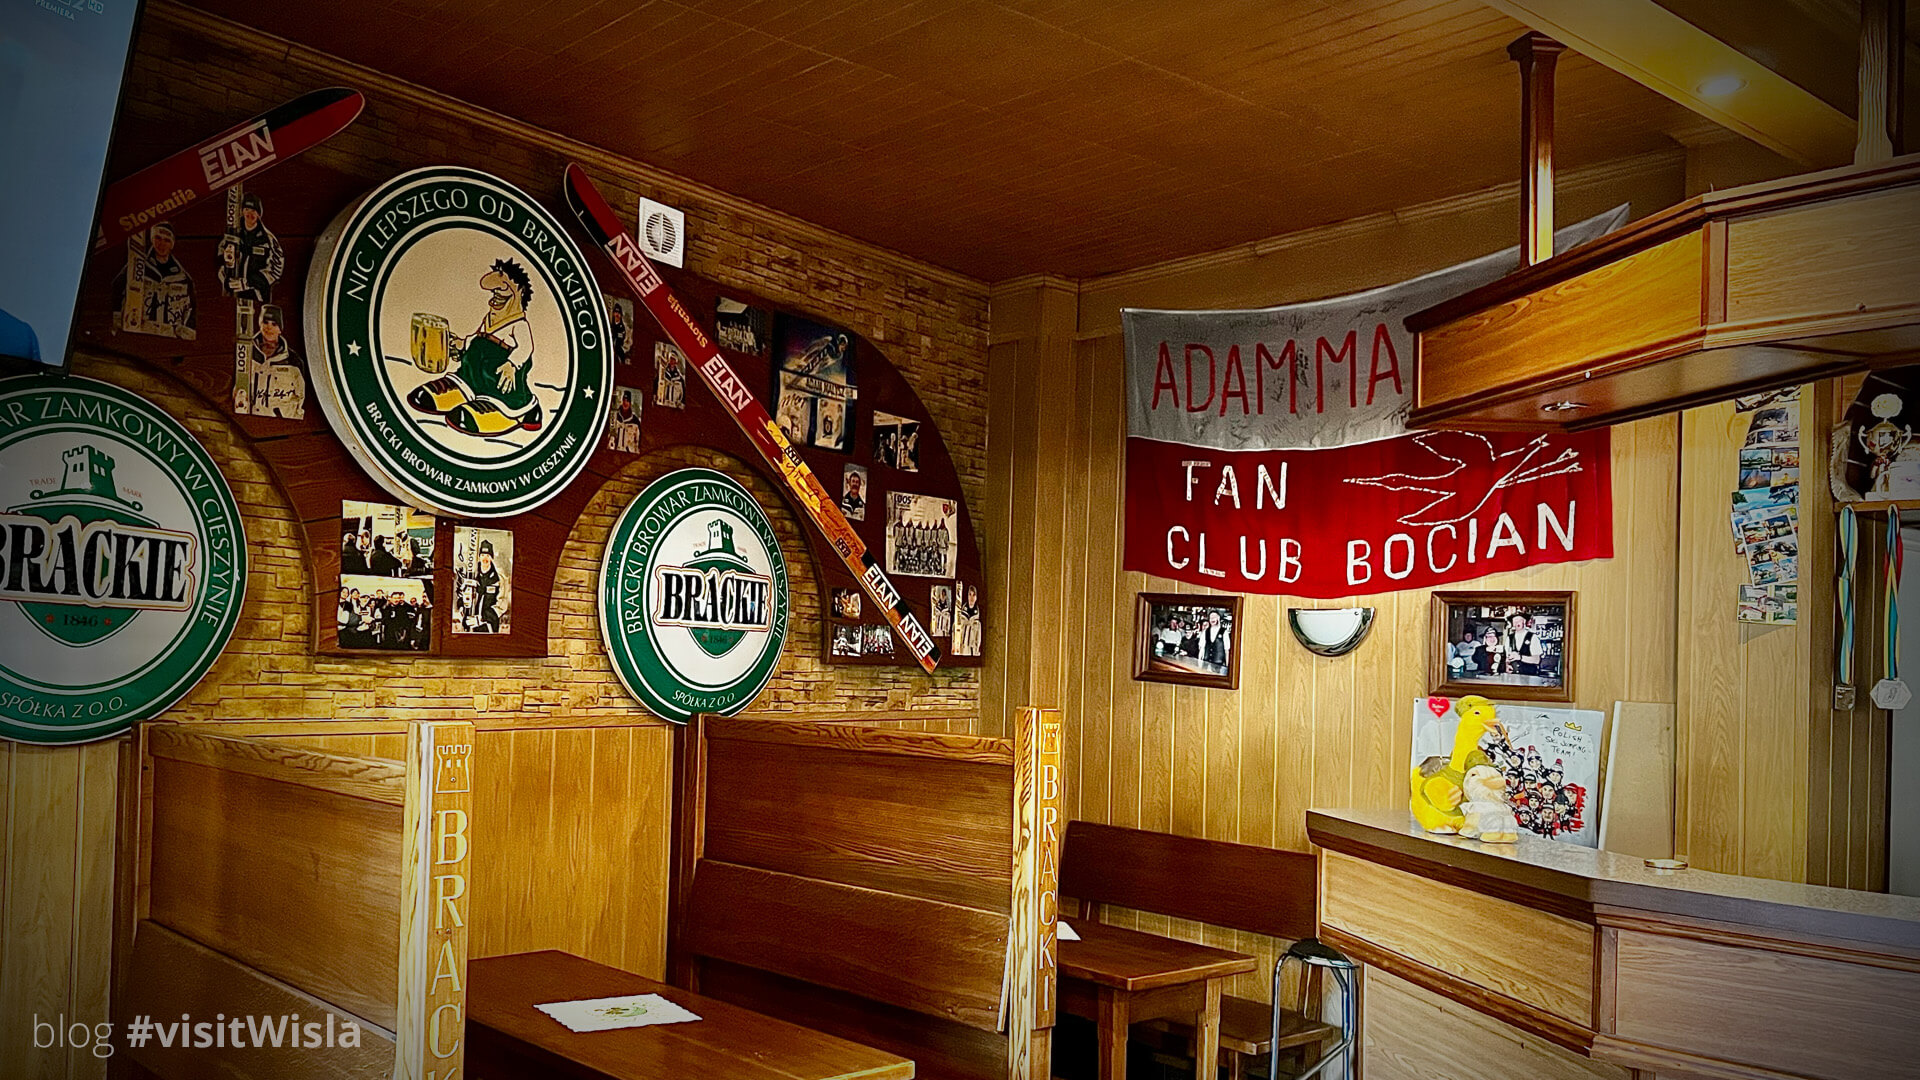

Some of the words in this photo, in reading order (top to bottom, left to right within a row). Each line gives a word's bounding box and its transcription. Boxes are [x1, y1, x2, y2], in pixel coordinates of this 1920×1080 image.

[201, 127, 275, 183] ELAN
[119, 187, 195, 231] Slovenija
[346, 251, 375, 301] NIC
[368, 188, 468, 250] LEPSZEGO
[479, 194, 514, 223] OD
[522, 219, 597, 350] BRACKIEGO
[610, 235, 659, 294] ELAN
[667, 294, 708, 348] Slovenija
[238, 345, 246, 372] LOOS
[703, 357, 751, 410] ELAN
[1152, 339, 1296, 417] ADAM
[366, 402, 402, 451] BRACKI
[401, 448, 452, 487] BROWAR
[455, 476, 518, 494] ZAMKOWY
[519, 471, 531, 487] W
[532, 432, 577, 480] CIESZYNIE
[35, 396, 186, 463] ZAMKOWY
[185, 465, 209, 491] W
[201, 499, 231, 627] CIESZYNIE
[691, 486, 763, 527] ZAMKOWY
[1182, 461, 1287, 510] FAN
[633, 491, 691, 556] BROWAR
[763, 531, 774, 547] W
[1167, 526, 1301, 584] CLUB
[1347, 500, 1576, 586] BOCIAN
[0, 524, 189, 602] RACKIE
[863, 567, 898, 609] ELAN
[63, 614, 99, 627] 1846
[623, 559, 644, 635] BRACKI
[660, 572, 768, 626] BRACKIE
[772, 551, 787, 643] CIESZYNIE
[901, 617, 932, 656] ELAN
[0, 691, 66, 718] SPÓŁKA
[71, 704, 85, 718] Z
[88, 696, 128, 716] O.O.
[672, 690, 707, 708] SPÓŁKA
[709, 697, 715, 708] Z
[1039, 765, 1058, 1012] BRACKI
[428, 809, 468, 1080] BRAC
